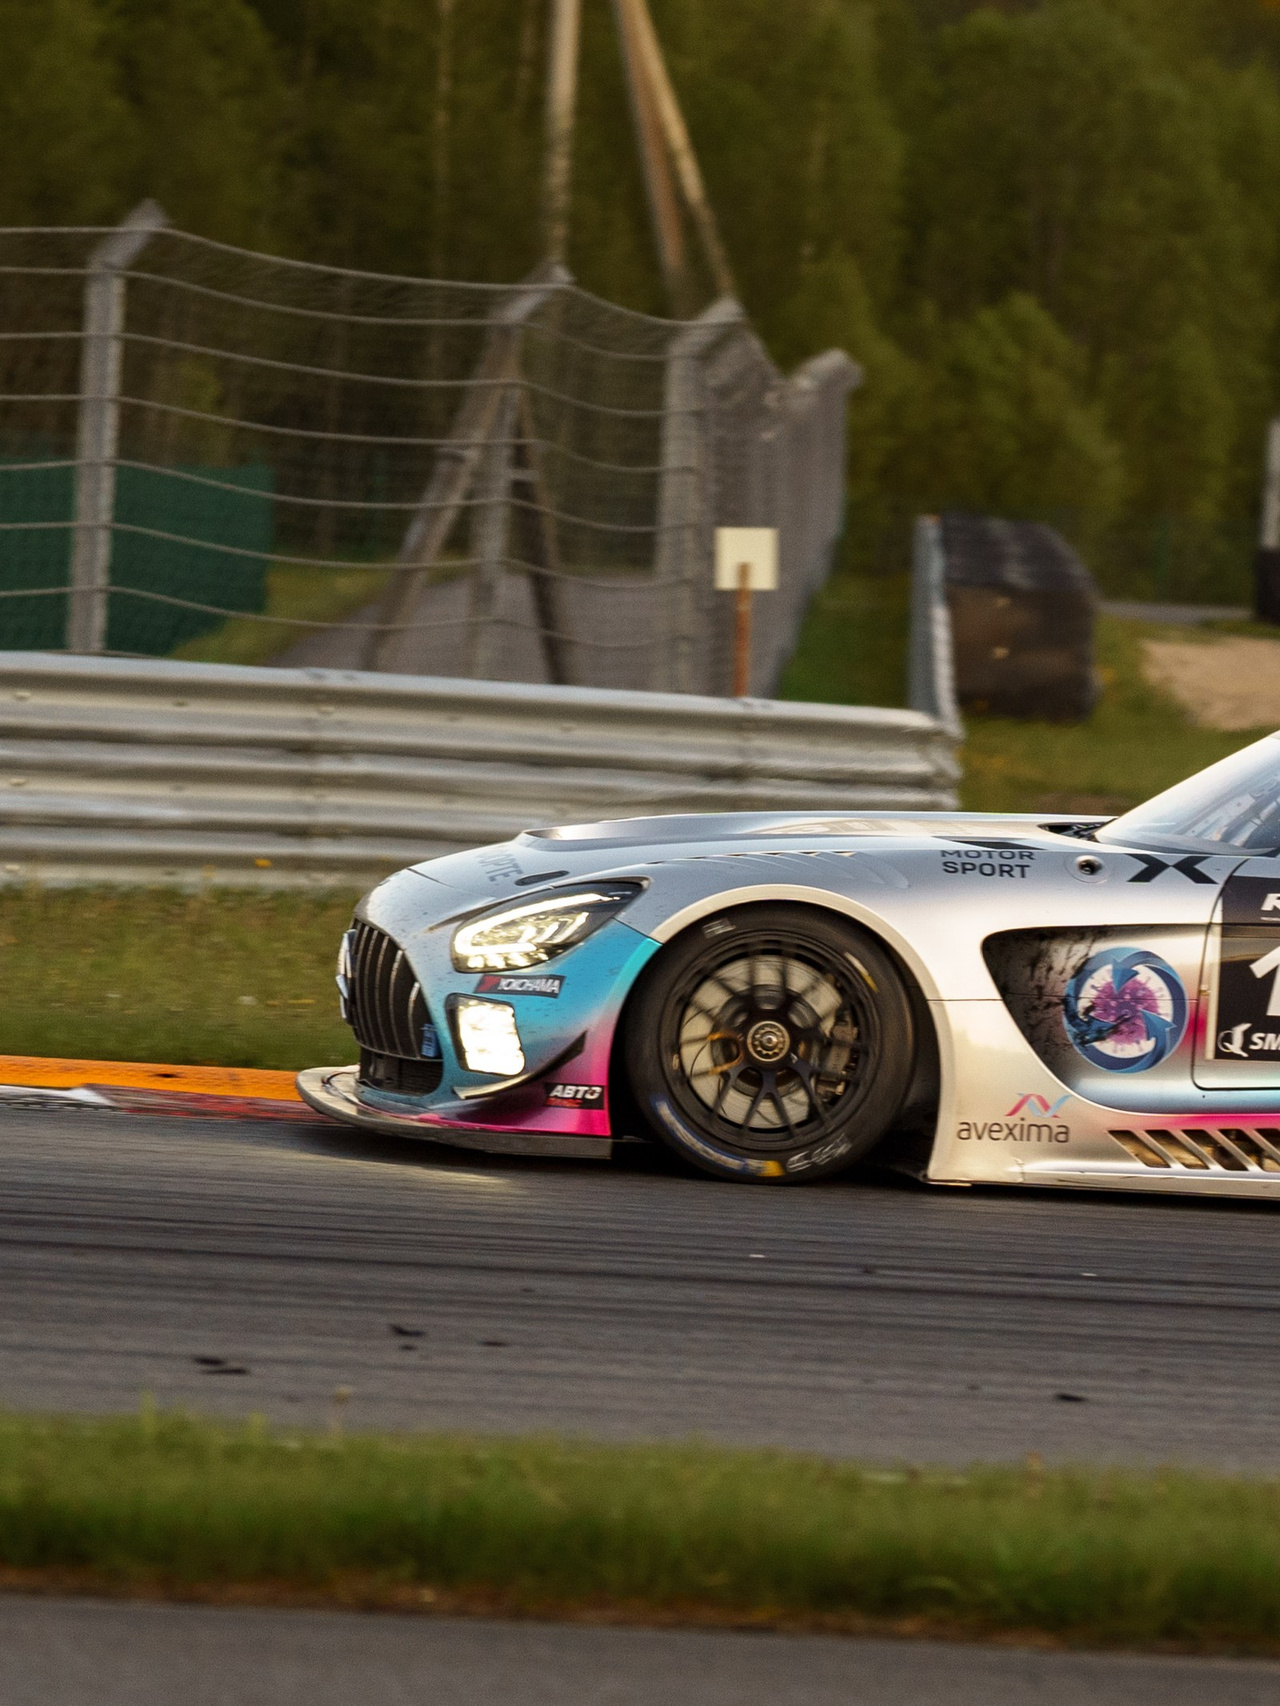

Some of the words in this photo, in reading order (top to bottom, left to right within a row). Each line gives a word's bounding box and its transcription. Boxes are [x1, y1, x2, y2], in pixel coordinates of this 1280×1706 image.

[942, 861, 1031, 879] SPORT
[549, 1084, 603, 1100] АВТО
[956, 1117, 1070, 1144] avexima
